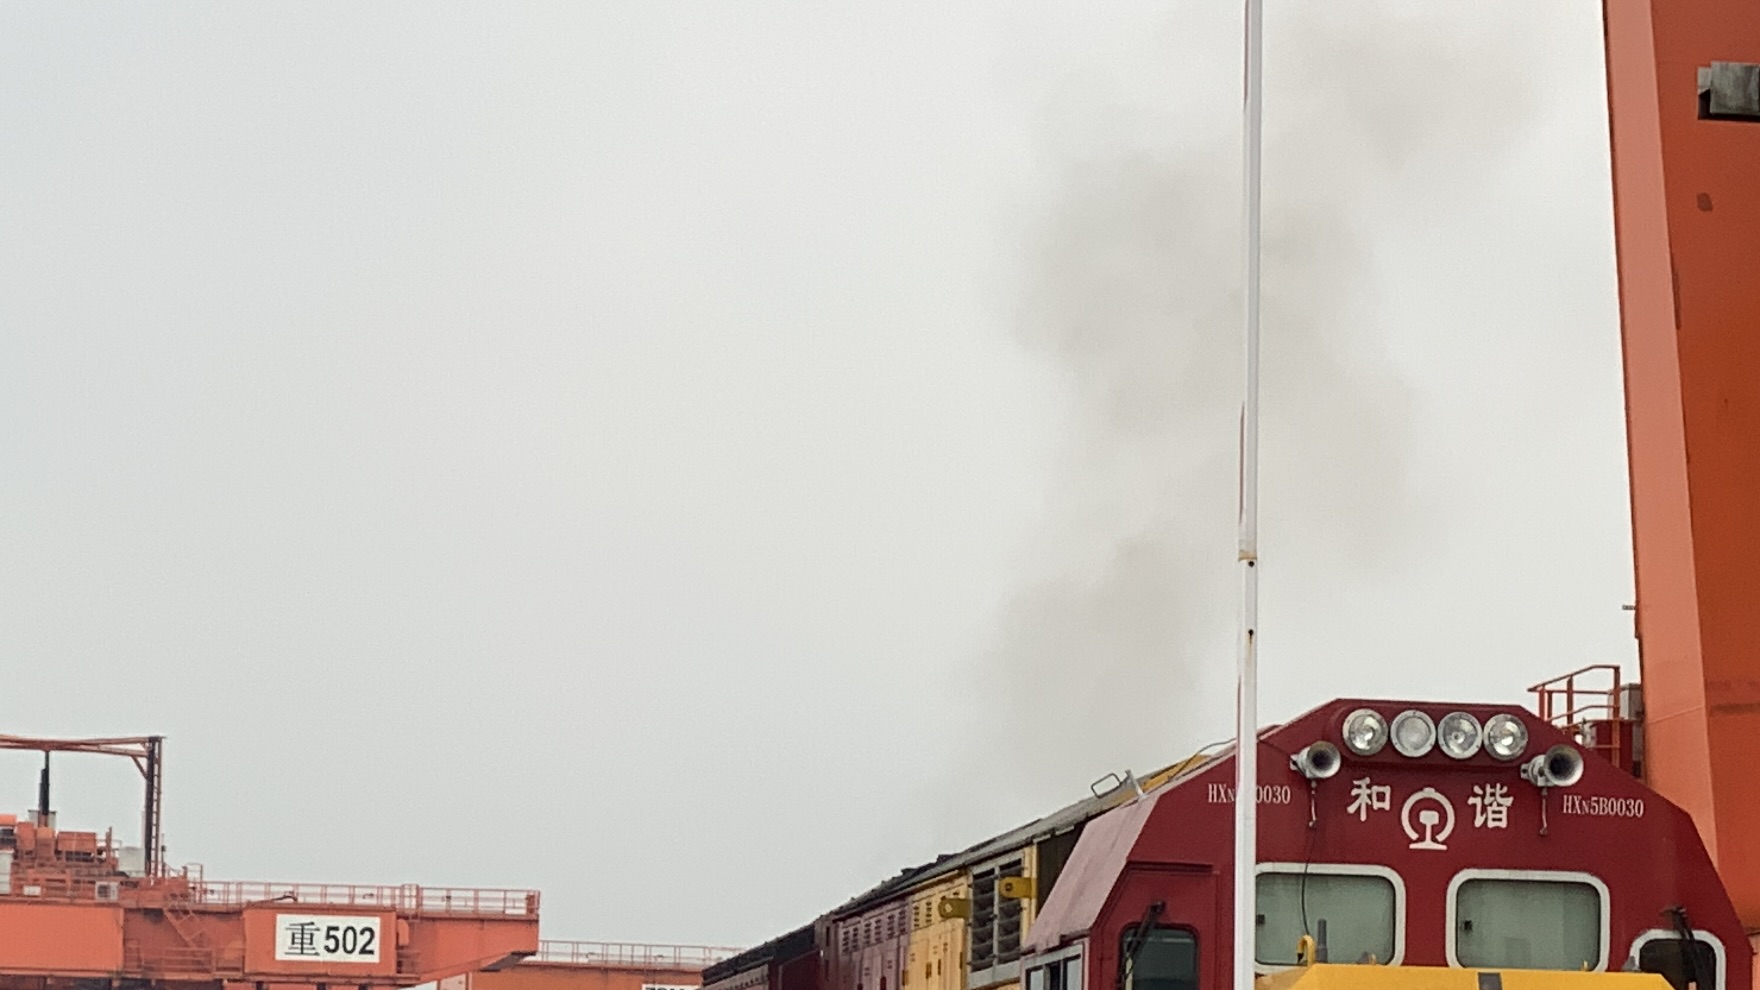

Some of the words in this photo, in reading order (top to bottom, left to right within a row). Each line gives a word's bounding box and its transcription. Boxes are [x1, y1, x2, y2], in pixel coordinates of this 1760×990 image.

[1208, 783, 1291, 804] HXN0030
[1346, 776, 1391, 822] 和
[1467, 783, 1514, 829] 谐
[284, 921, 375, 956] 重502
